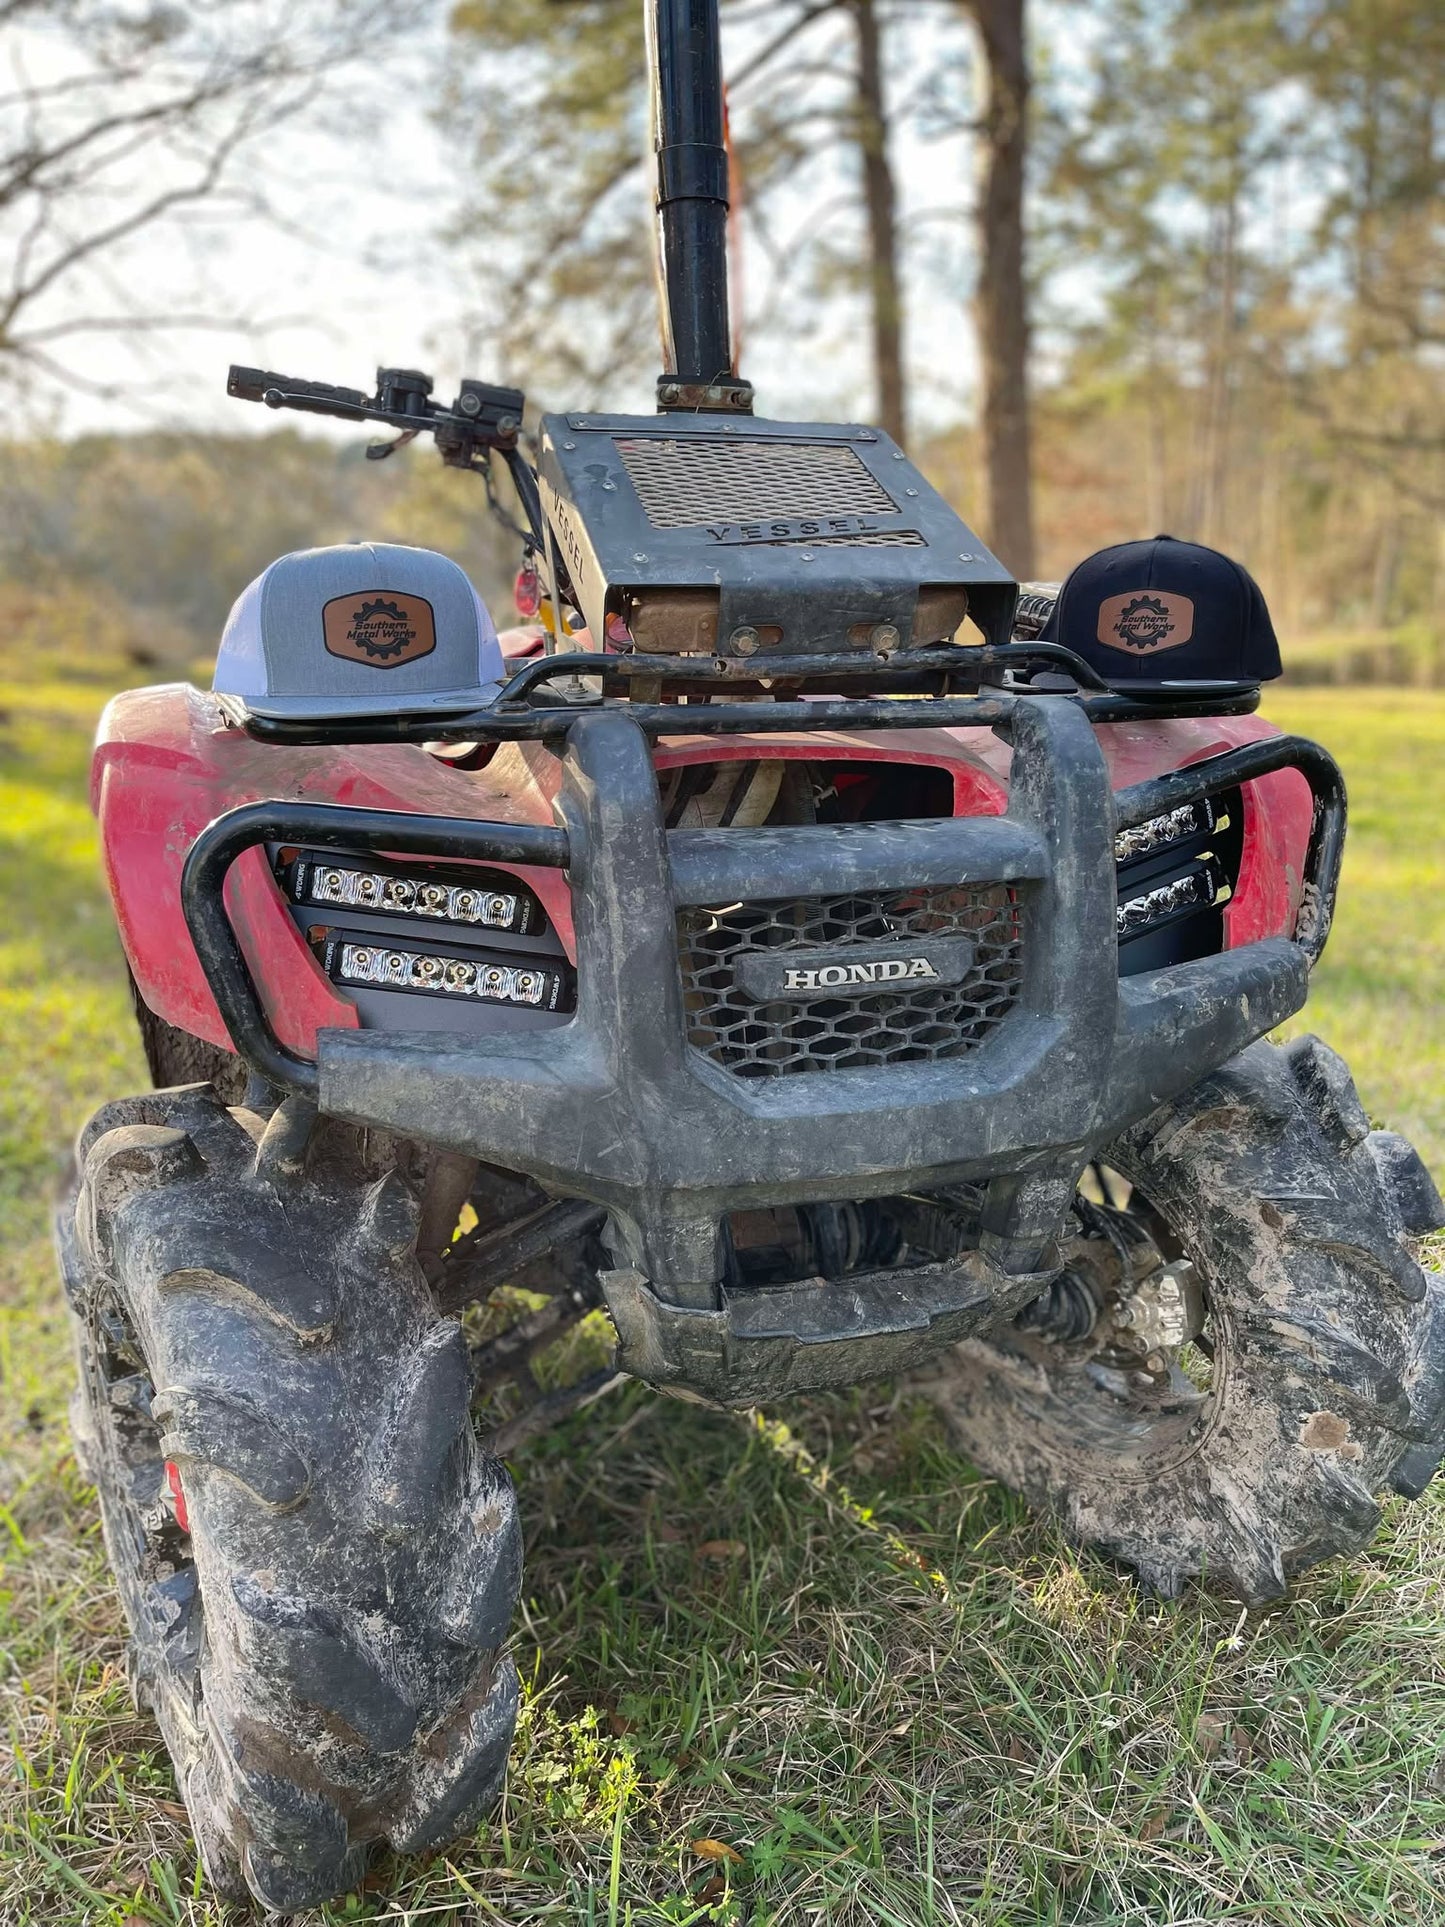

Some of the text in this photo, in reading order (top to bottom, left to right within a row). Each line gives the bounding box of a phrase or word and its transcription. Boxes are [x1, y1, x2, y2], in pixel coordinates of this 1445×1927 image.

[706, 519, 878, 541] VESSEL
[553, 487, 584, 585] VESSEL
[1121, 615, 1168, 623] Southern
[354, 621, 408, 630] Southern
[1113, 622, 1176, 632] Metal Works
[346, 629, 417, 640] Metal Works
[784, 957, 938, 990] HONDA
